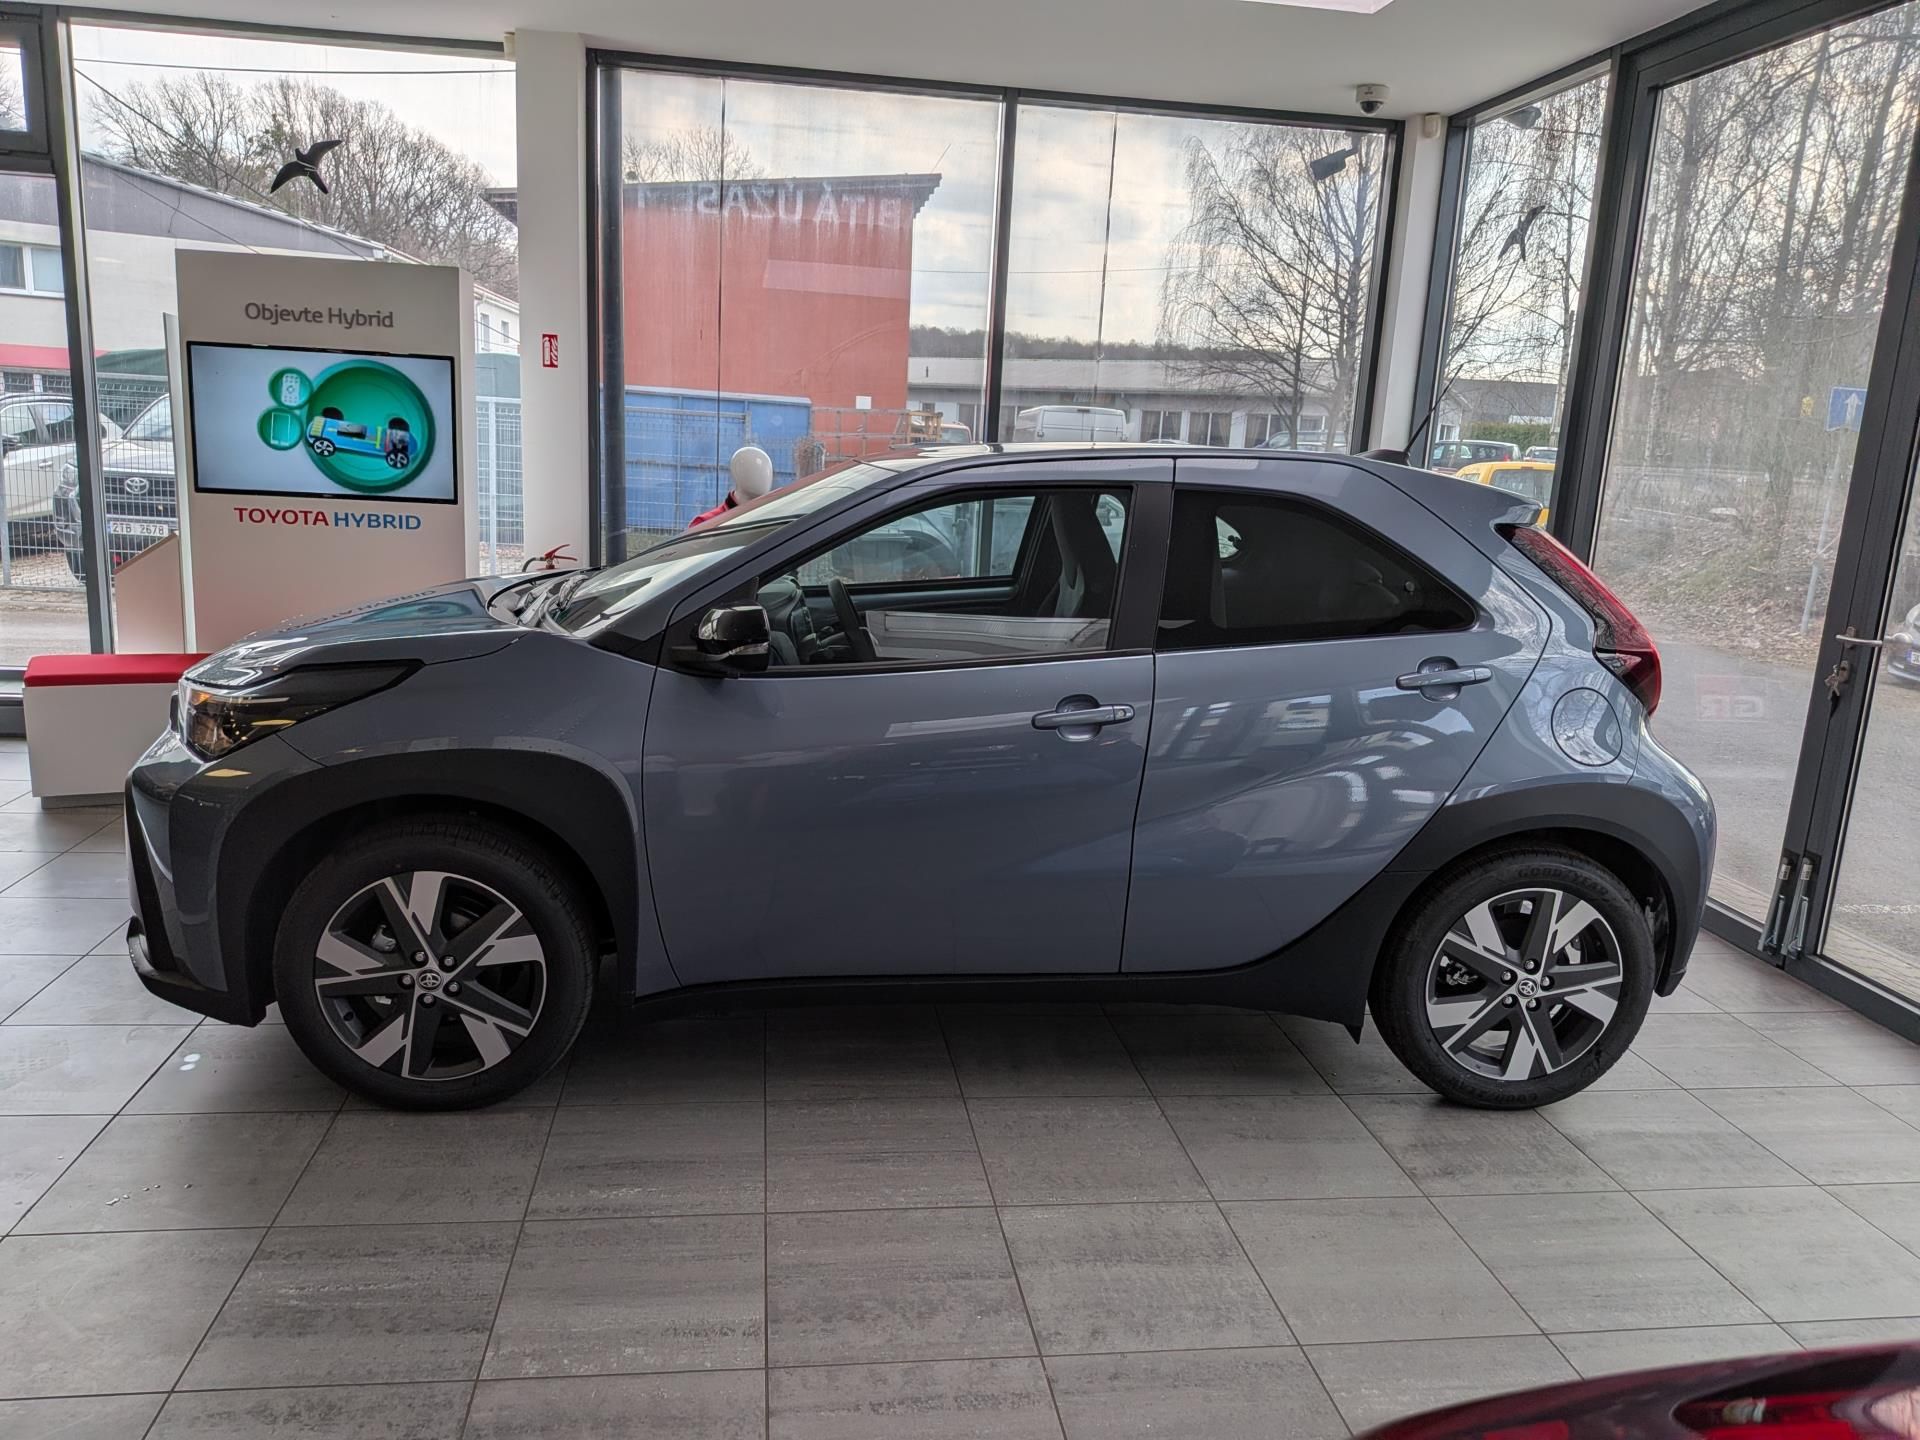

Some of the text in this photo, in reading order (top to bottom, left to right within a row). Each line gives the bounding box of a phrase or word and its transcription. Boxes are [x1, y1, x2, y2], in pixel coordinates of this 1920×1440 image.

[244, 302, 394, 330] Objevte Hybrid
[233, 507, 422, 531] TOYOTA HYBRID
